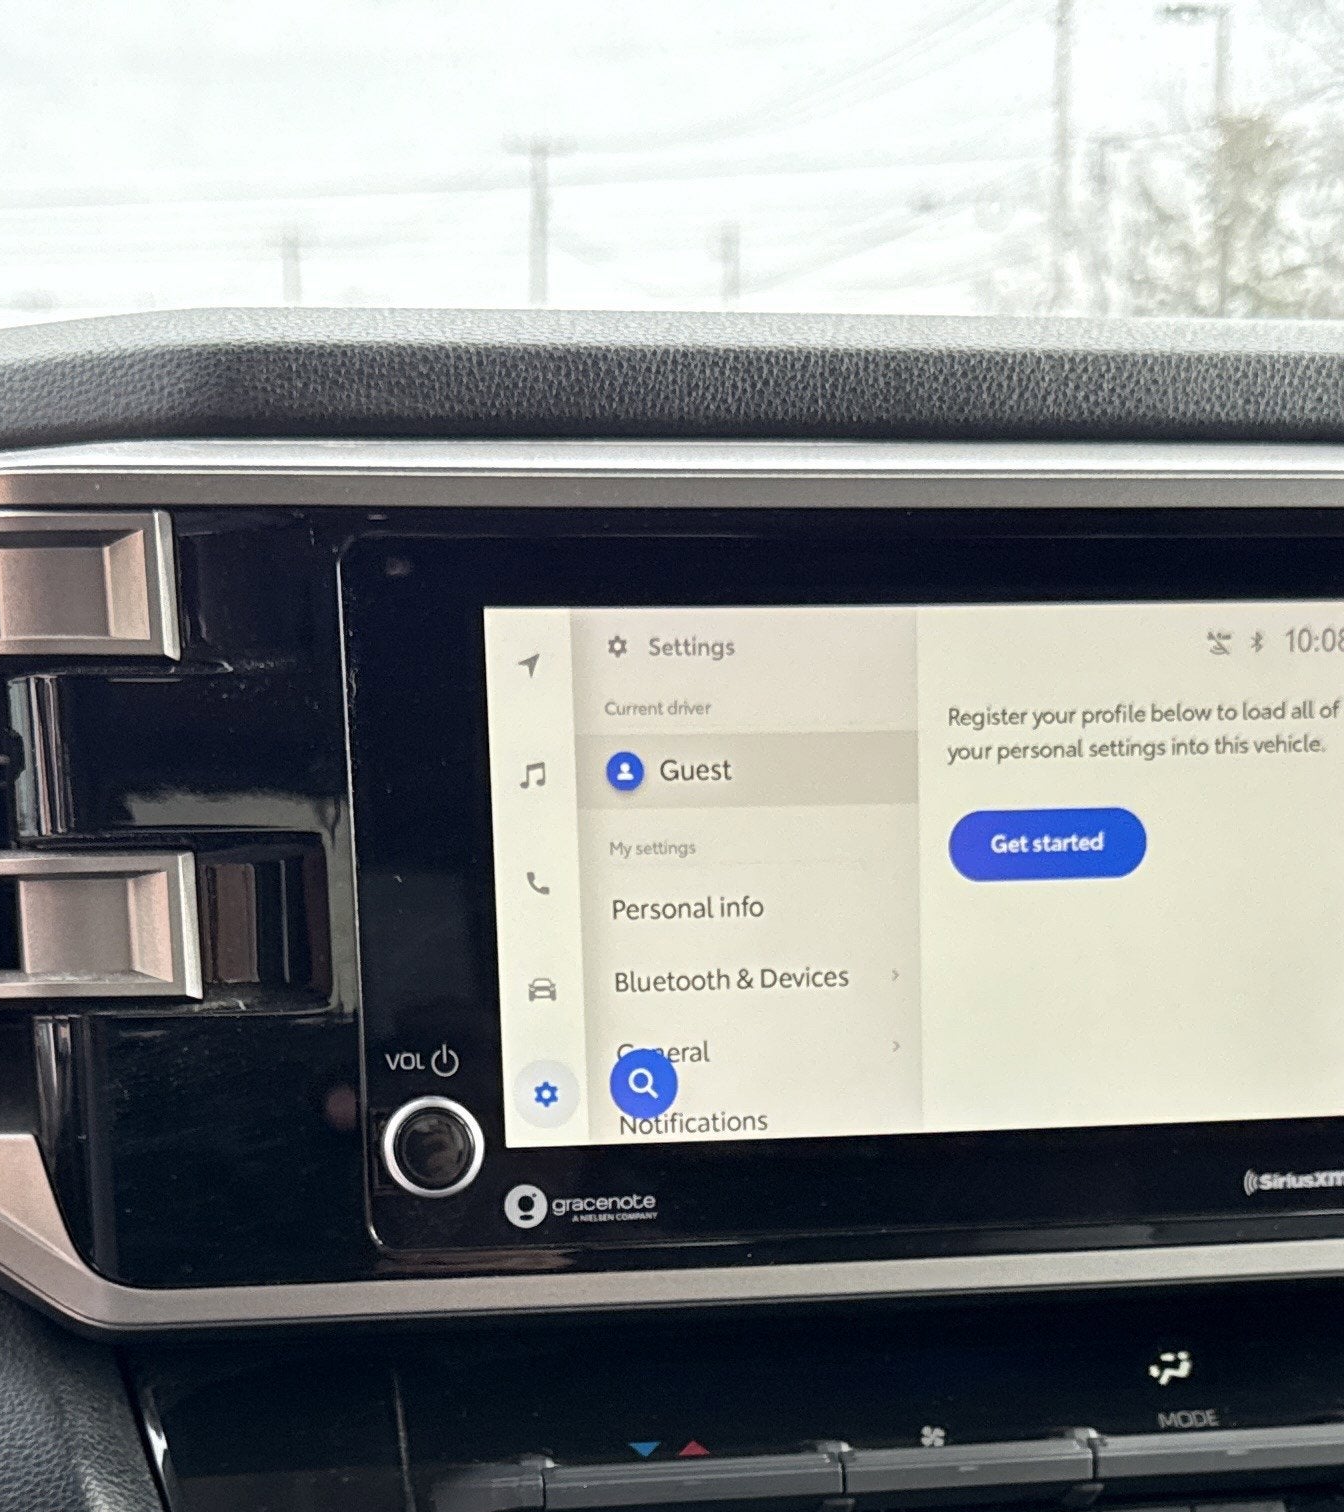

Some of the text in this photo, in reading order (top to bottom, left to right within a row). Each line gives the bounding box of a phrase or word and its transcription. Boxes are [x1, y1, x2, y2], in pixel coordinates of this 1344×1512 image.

[648, 636, 736, 662] Settings
[604, 700, 712, 717] Current driver
[947, 699, 1342, 731] Register your profile below to load all of
[947, 733, 1328, 766] your personal settings into this vehicle.
[659, 758, 733, 783] Guest
[609, 840, 696, 859] My settings
[990, 830, 1104, 854] Get started
[611, 895, 765, 921] Personal info
[614, 965, 850, 993] Bluetooth & Devices
[384, 1052, 426, 1071] VOL
[616, 1039, 711, 1063] Geral
[620, 1111, 768, 1136] Notifications
[551, 1193, 657, 1217] gracenote
[615, 1211, 659, 1222] COMPANY
[1158, 1408, 1219, 1430] MODE
